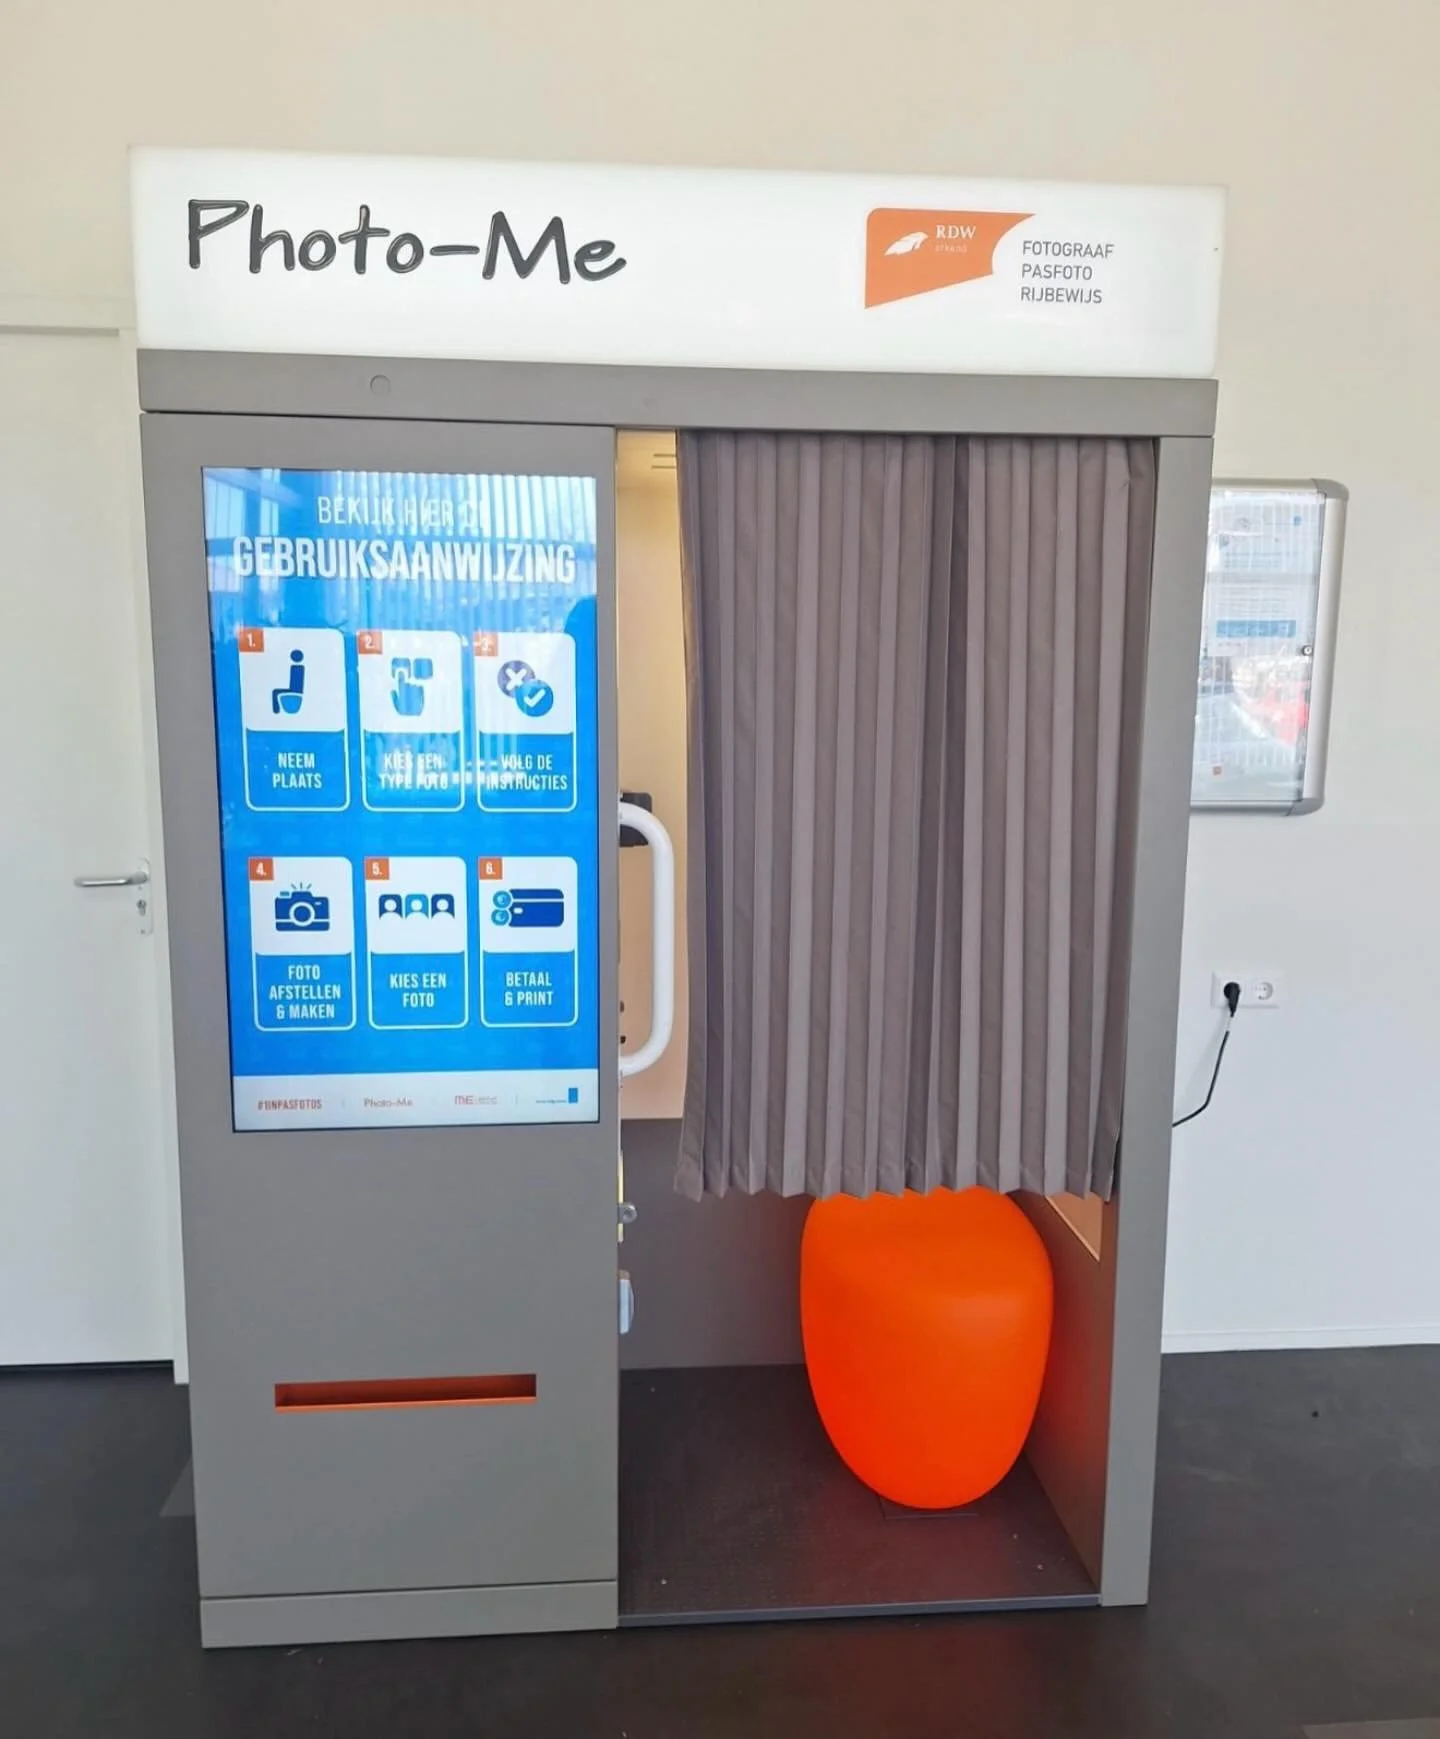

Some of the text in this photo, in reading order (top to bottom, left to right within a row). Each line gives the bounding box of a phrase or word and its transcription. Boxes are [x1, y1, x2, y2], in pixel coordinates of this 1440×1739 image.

[935, 223, 977, 240] RDW
[188, 199, 627, 285] Photo-Me
[1022, 239, 1115, 259] FOTOGRAAF
[1021, 263, 1093, 281] PASFOTO
[1020, 286, 1103, 304] RIJBEWIJS
[317, 496, 395, 526] BEKIJK
[404, 498, 454, 527] HIER
[232, 536, 576, 584] GEBRUIKSAANWIJZING
[247, 634, 257, 648] 1.
[364, 635, 376, 649] 2.
[277, 752, 315, 769] NEEM
[384, 751, 442, 769] KIES EEN
[501, 754, 553, 770] VOLG DE
[272, 773, 323, 789] PLAATS
[379, 773, 413, 790] TYPE
[486, 774, 568, 791] INSTRUCTIES
[255, 861, 267, 876] 4.
[371, 861, 382, 876] 5.
[288, 964, 320, 980] FOTO
[389, 972, 447, 989] KIES EEN
[506, 971, 552, 987] BETAAL
[269, 984, 341, 1000] AFSTELLEN
[403, 992, 435, 1008] FOTO
[504, 991, 553, 1006] & PRINT
[277, 1003, 335, 1020] & MAKEN
